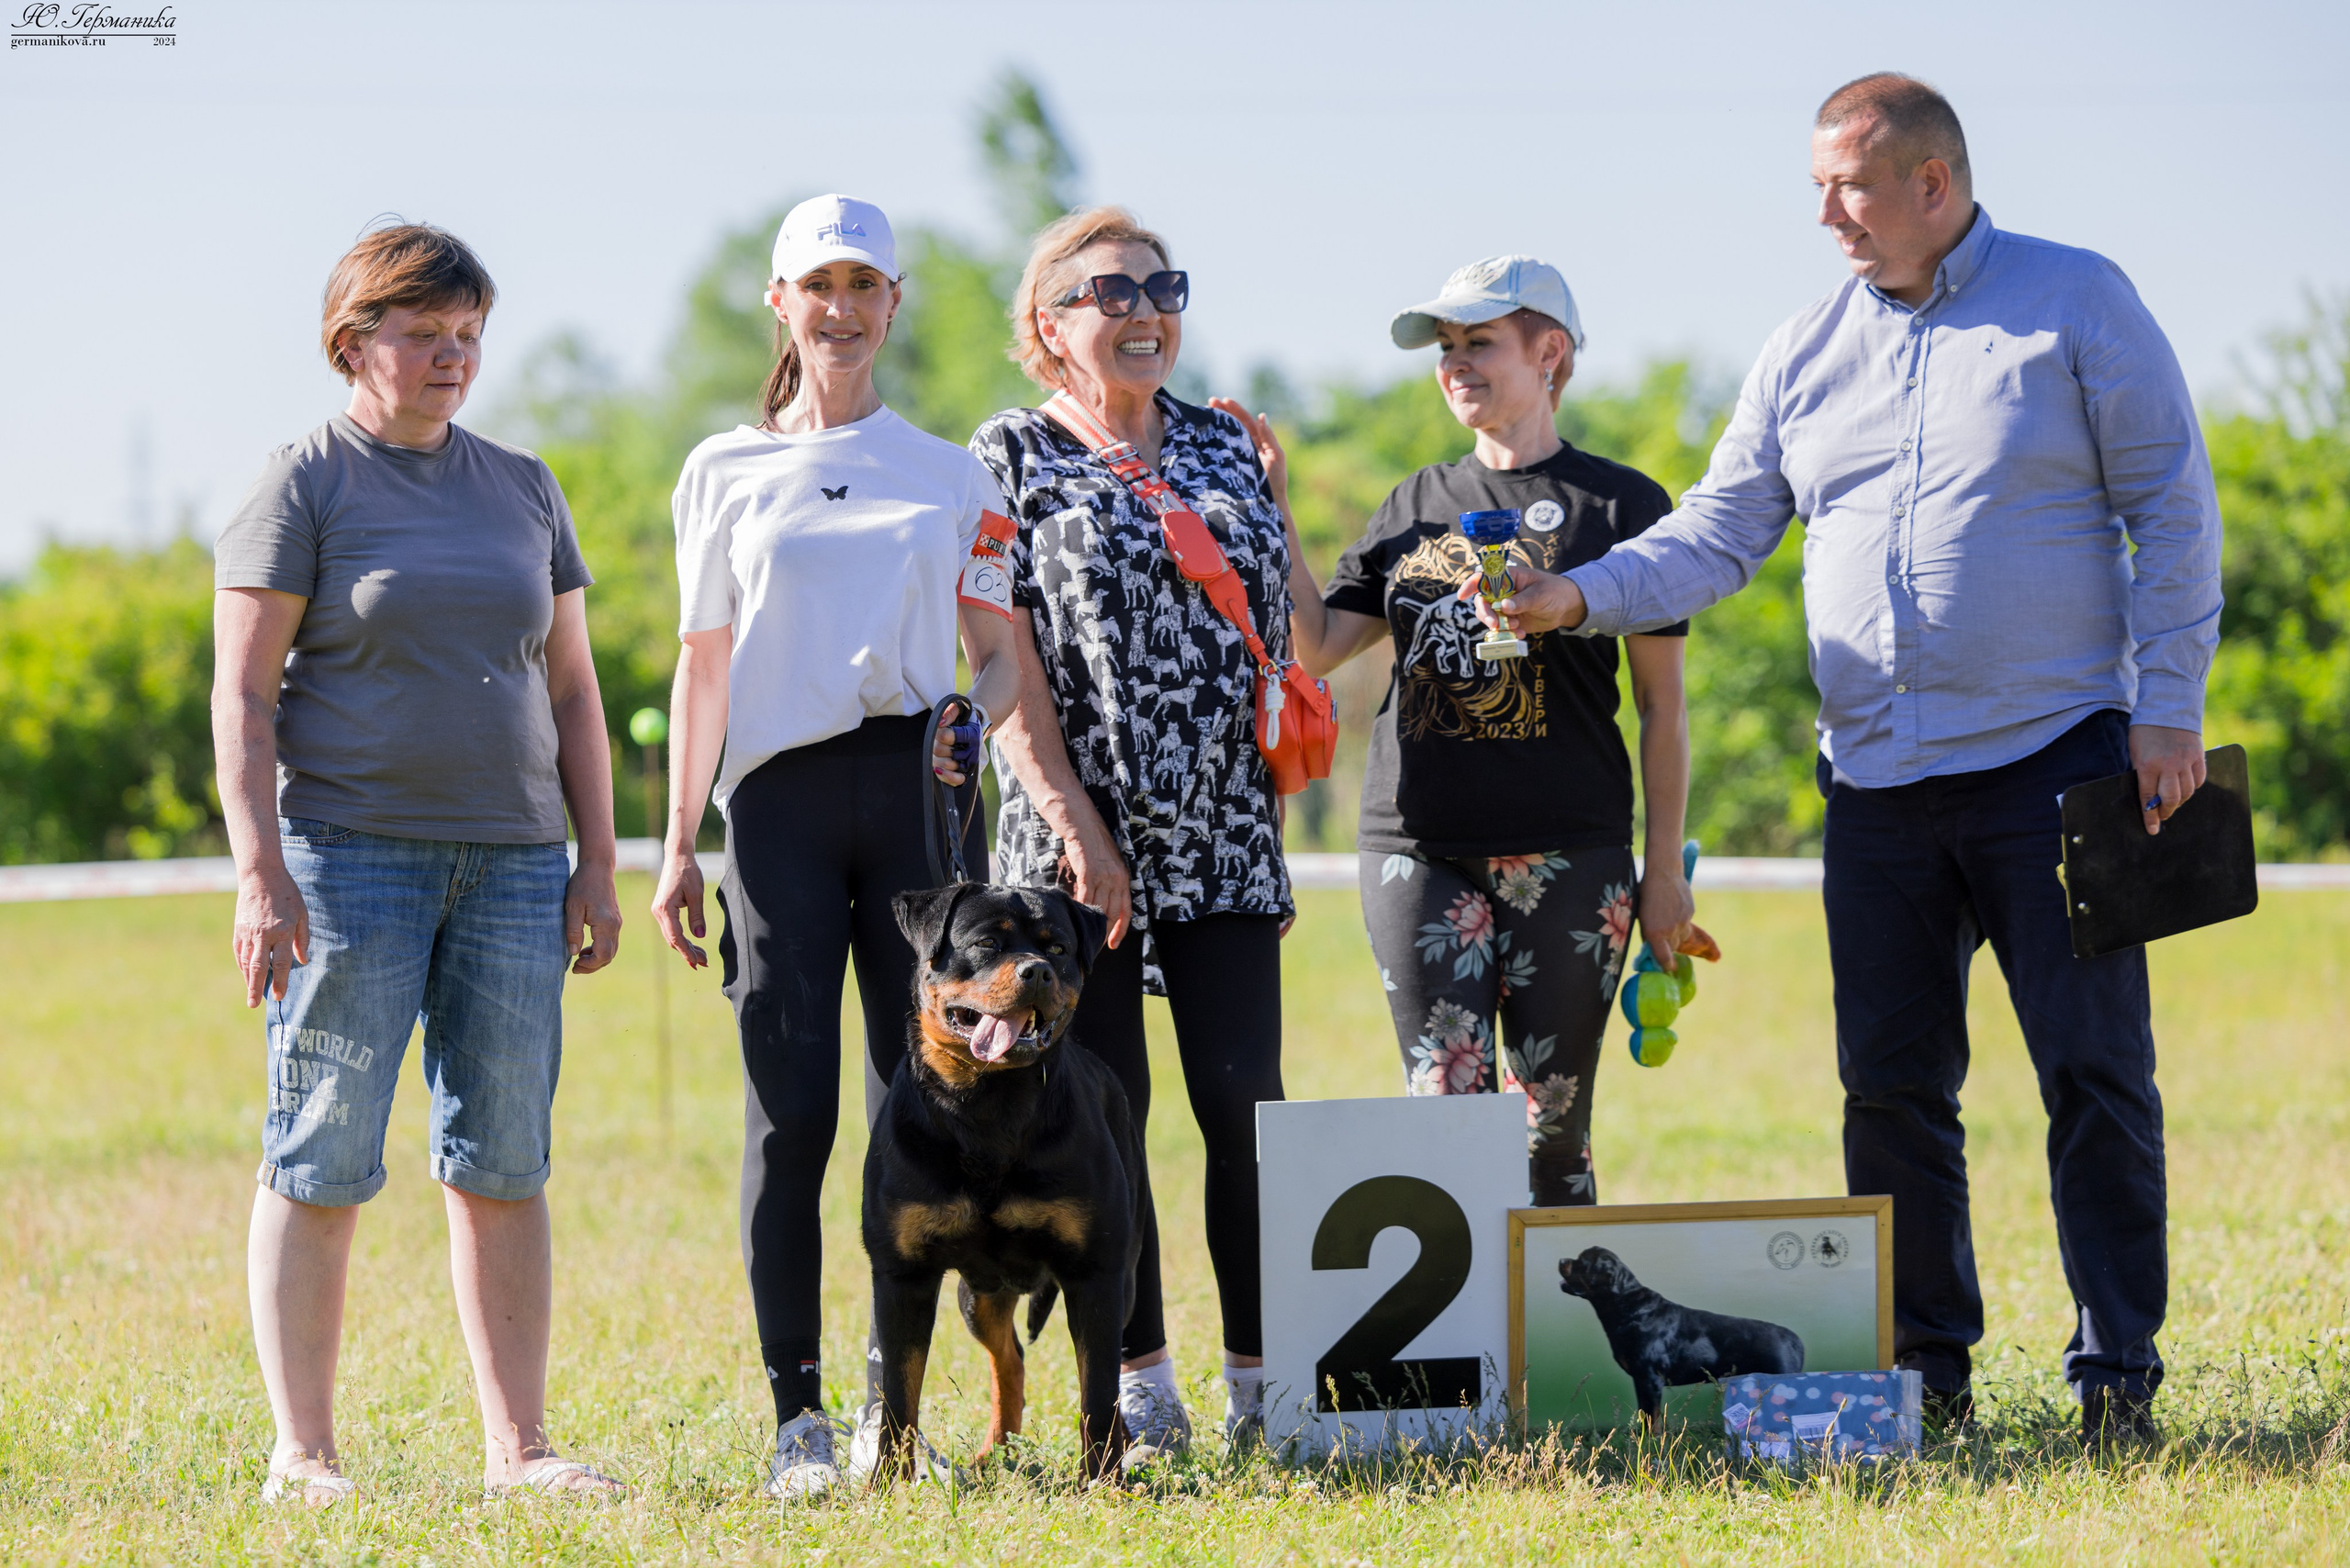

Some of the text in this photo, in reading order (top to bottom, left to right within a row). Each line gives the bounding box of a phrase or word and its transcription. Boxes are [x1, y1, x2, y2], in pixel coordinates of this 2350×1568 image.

[816, 221, 867, 241] FILA
[975, 566, 1007, 602] 63
[1534, 664, 1548, 738] ТВЕРИ
[1475, 722, 1526, 740] 2023
[295, 1027, 375, 1072] WORLD
[280, 1057, 339, 1100] ONE
[1312, 1175, 1481, 1413] 2
